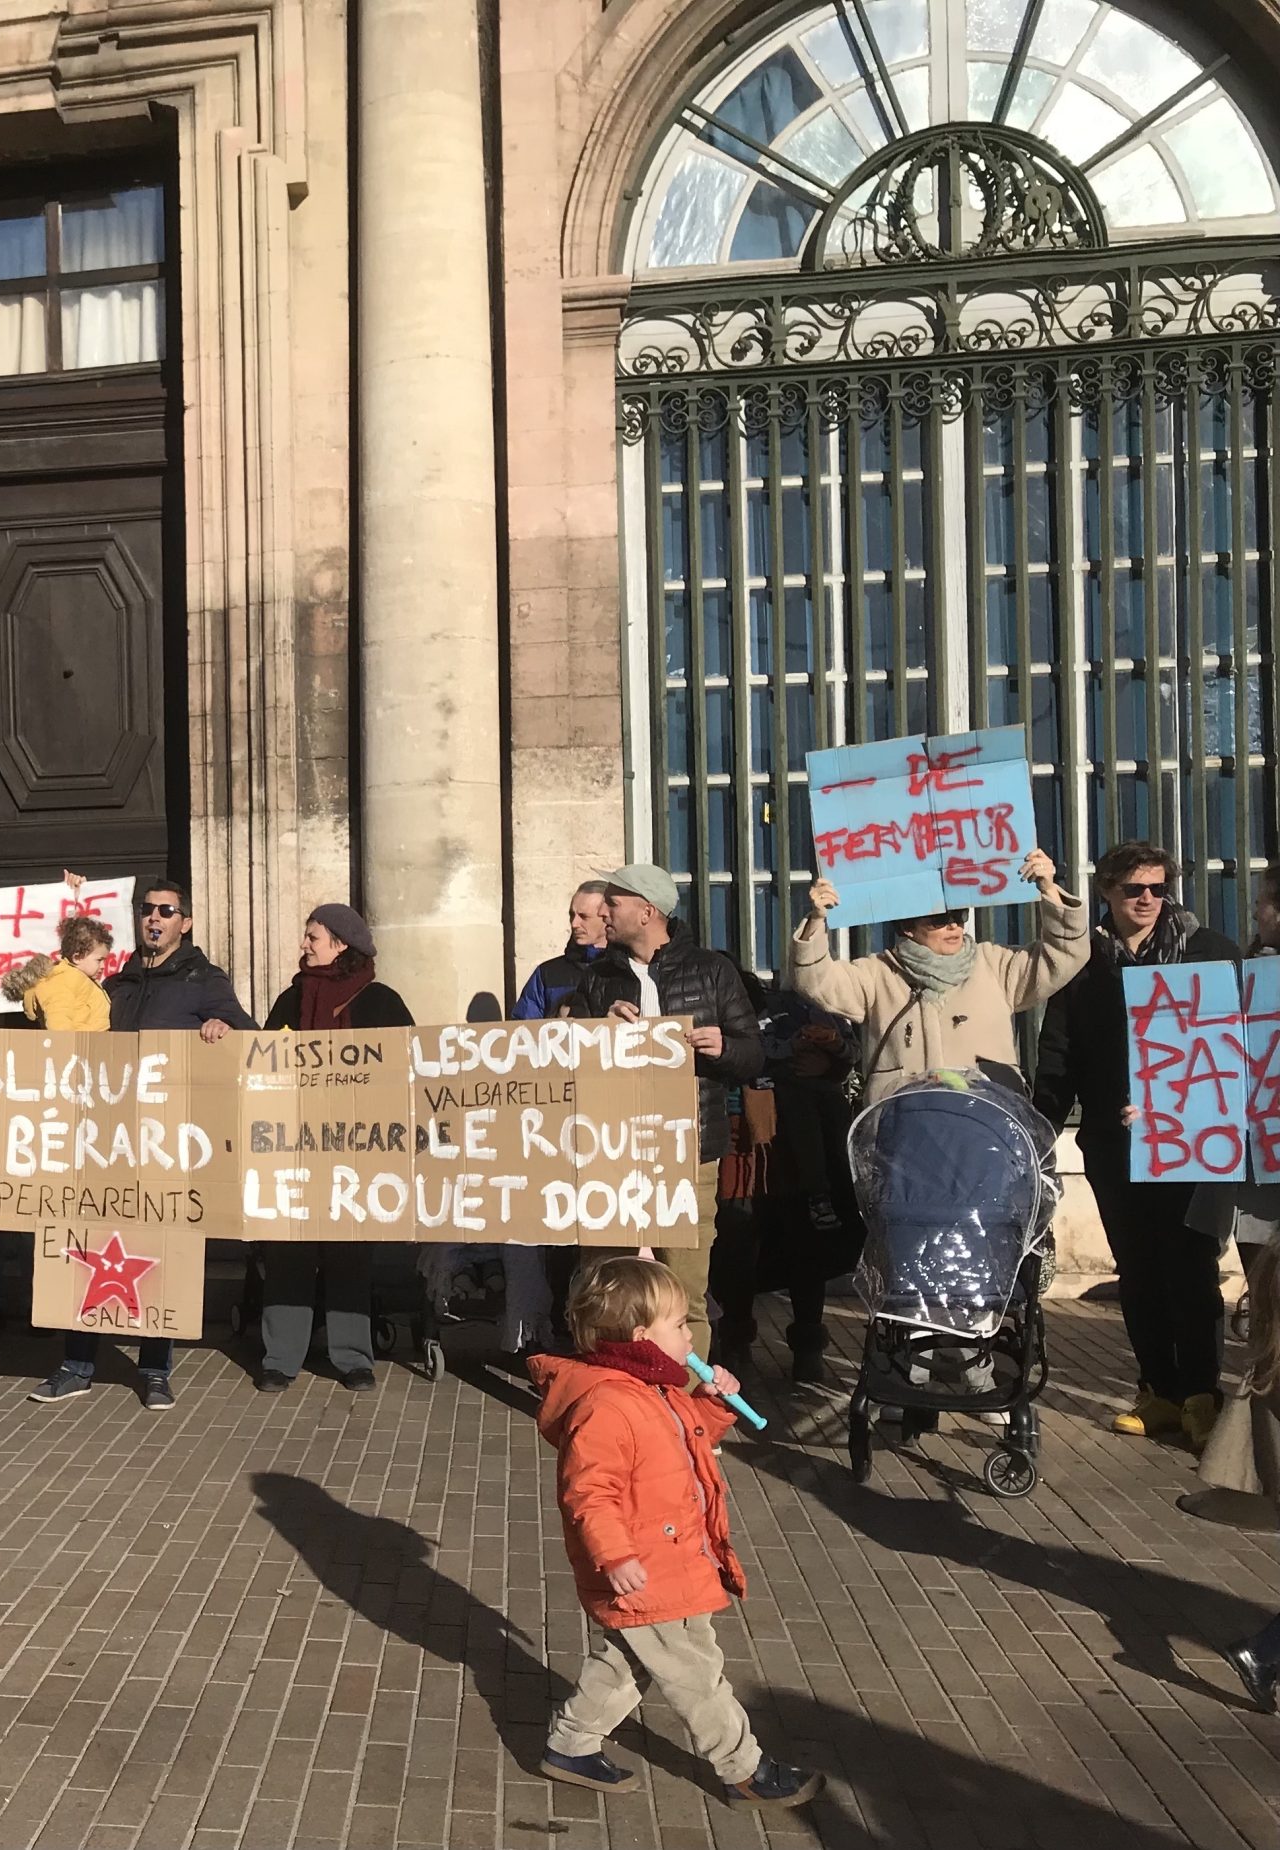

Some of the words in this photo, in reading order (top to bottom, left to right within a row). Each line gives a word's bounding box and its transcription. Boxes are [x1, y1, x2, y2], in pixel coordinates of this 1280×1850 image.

[906, 746, 985, 797] DE
[945, 857, 1011, 895] ES
[300, 1072, 321, 1088] DE
[325, 1071, 371, 1088] FRANCE
[423, 1080, 577, 1113] VALBARELLE
[6, 1107, 213, 1177] BÉRARD
[429, 1108, 498, 1160] LE
[520, 1108, 697, 1169] ROUET
[243, 1168, 311, 1220] LE
[329, 1165, 529, 1231] ROUET
[43, 1226, 89, 1264] EN
